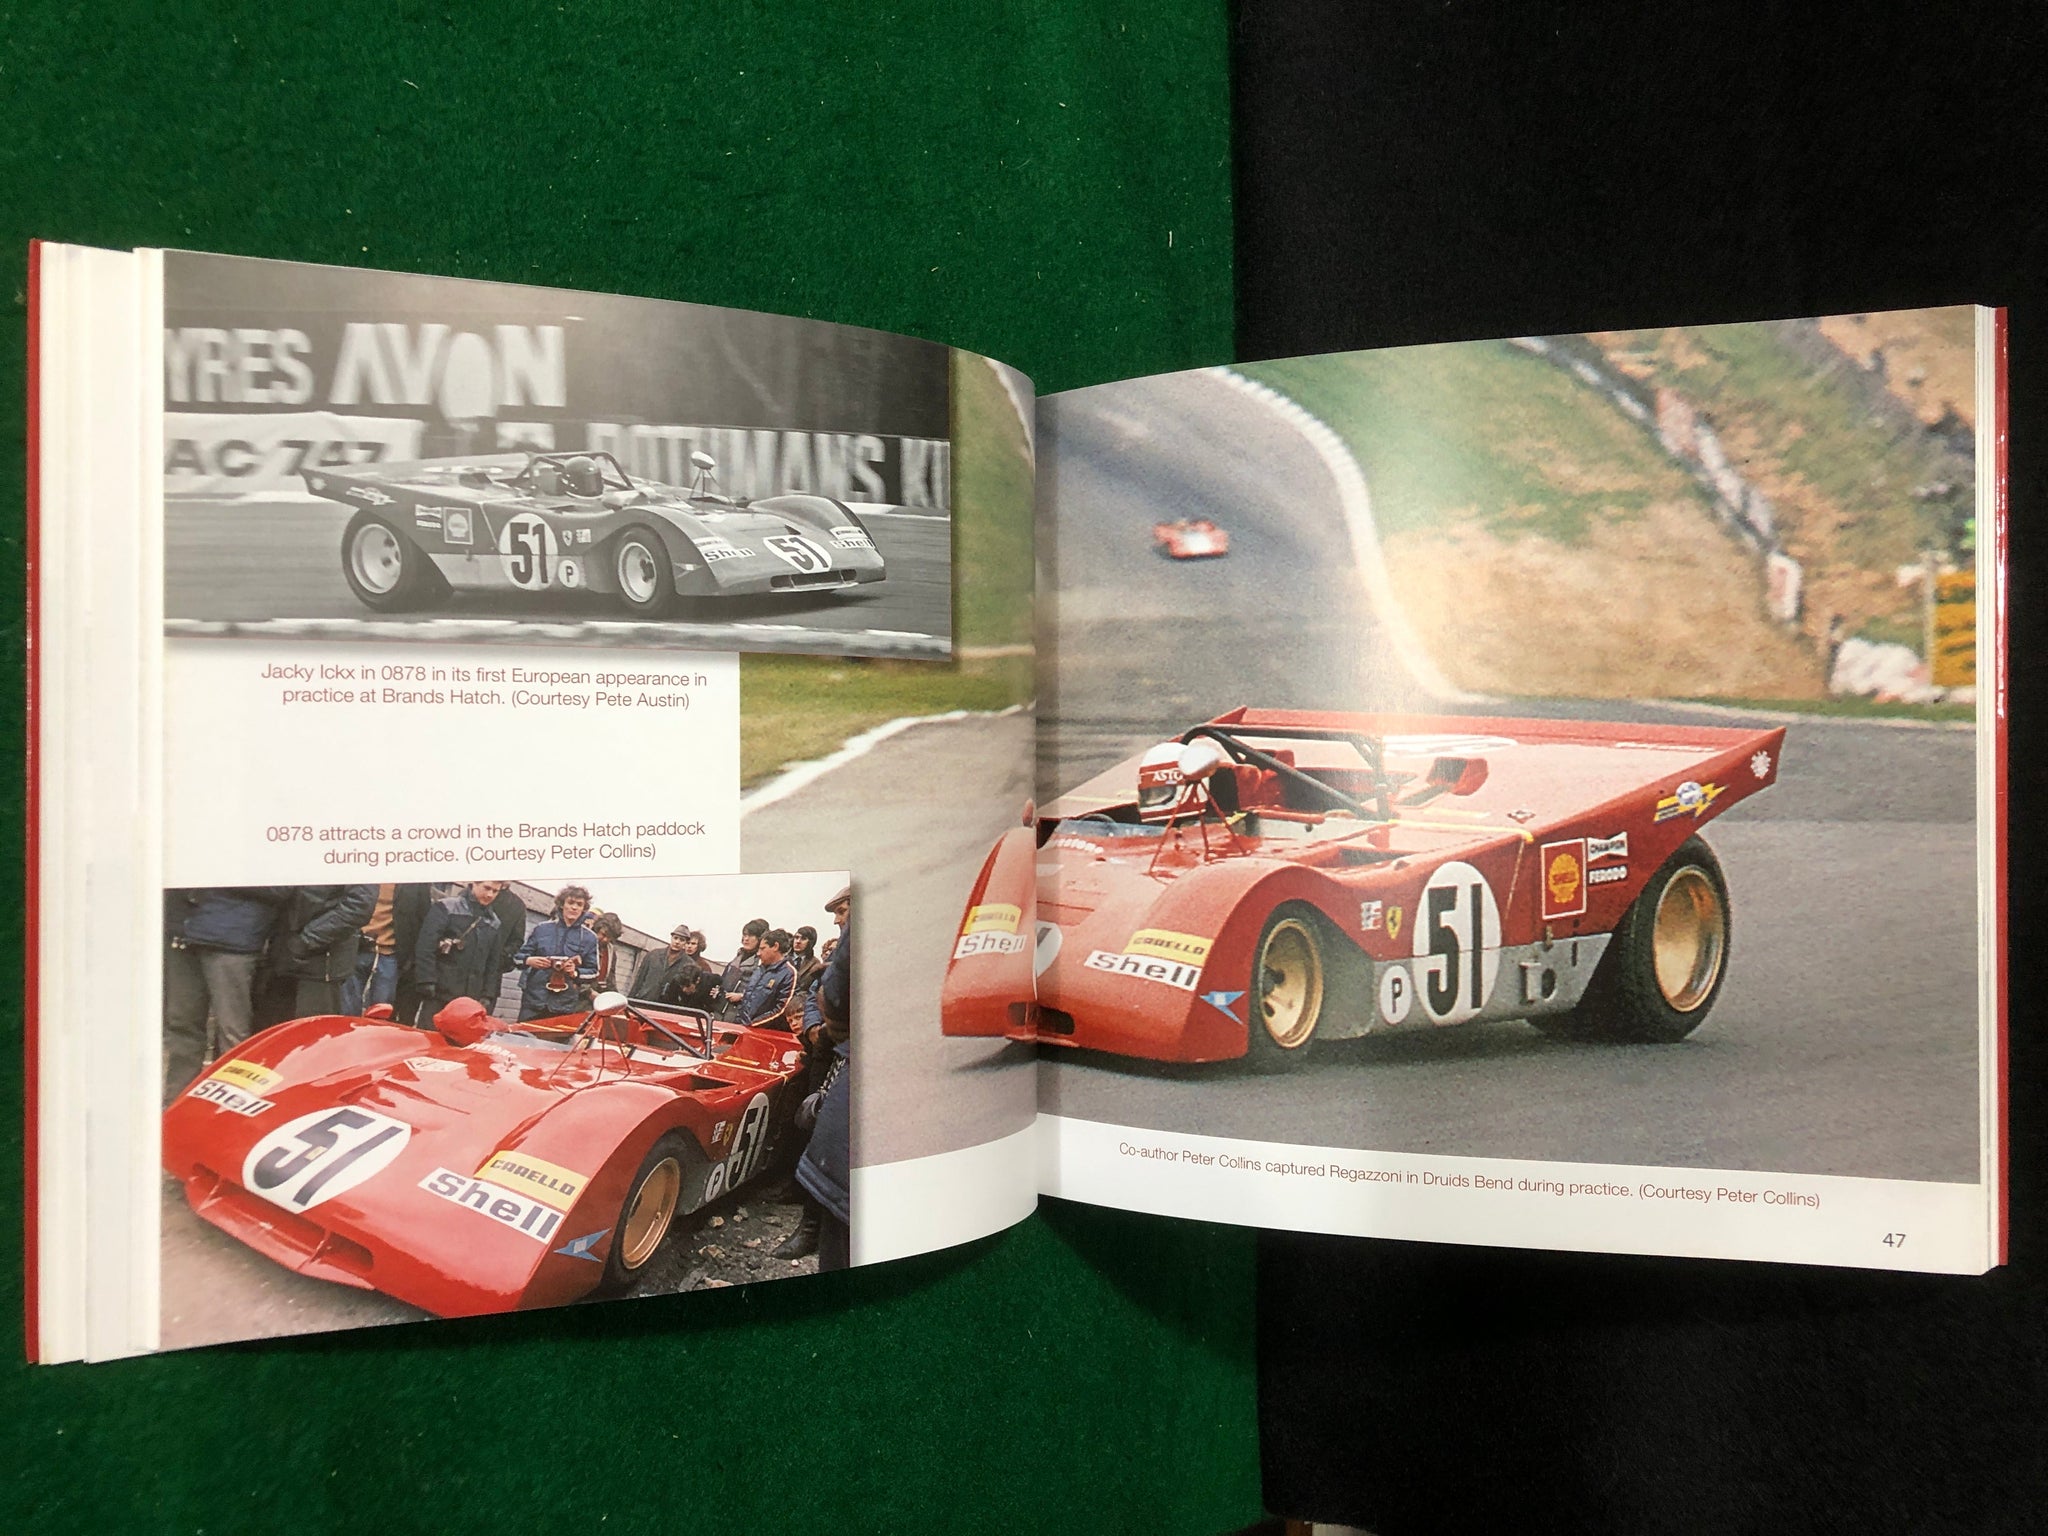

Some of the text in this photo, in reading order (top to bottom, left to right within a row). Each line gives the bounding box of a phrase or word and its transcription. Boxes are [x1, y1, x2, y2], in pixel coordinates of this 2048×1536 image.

[330, 323, 566, 420] AVON
[509, 522, 548, 584] 51
[768, 537, 829, 570] 51
[566, 565, 574, 583] P
[261, 663, 707, 687] Jacky Ickx in 0878 in its first European appearance in
[283, 688, 690, 710] practice at Brands Hatch. (Courtesy Pete Austin)
[267, 821, 705, 841] 0878 attracts a crowd in the Brands Hatch paddock
[324, 843, 656, 867] during practice. (Courtesy Peter Collins)
[961, 933, 1025, 954] Shell
[1427, 883, 1482, 1016] 51
[1093, 953, 1197, 987] Shell
[1391, 977, 1402, 1013] P
[193, 1081, 270, 1115] Shell
[253, 1109, 404, 1206] 51
[728, 1105, 767, 1189] 51
[490, 1159, 576, 1196] CARELLO
[710, 1170, 721, 1196] P
[1119, 1142, 1821, 1209] Co-author Peter Collins captured Regazzoni in Druids Bend during practice. (Courtesy Peter Collins)
[427, 1173, 560, 1239] Shell
[1882, 1232, 1906, 1248] 47
